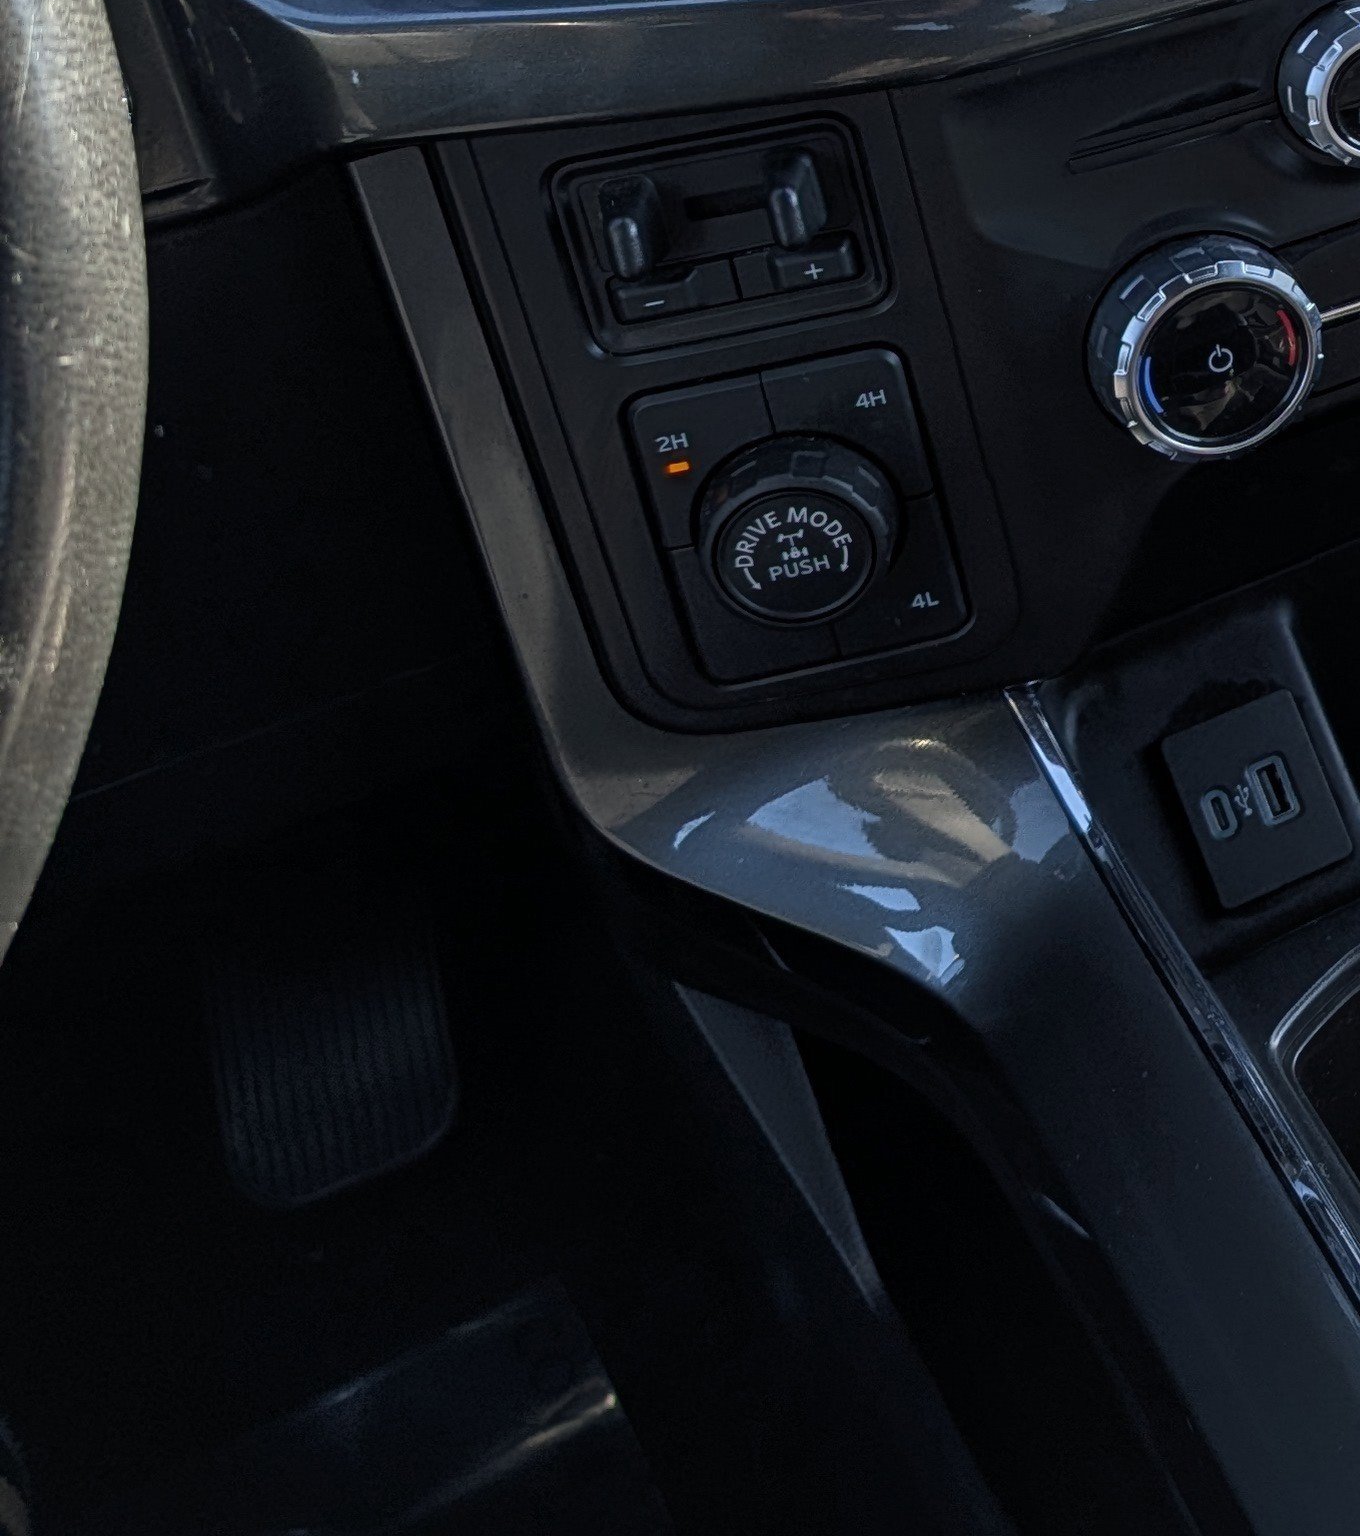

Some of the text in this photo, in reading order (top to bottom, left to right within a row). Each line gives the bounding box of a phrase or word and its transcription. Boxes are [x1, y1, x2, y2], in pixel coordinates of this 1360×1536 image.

[855, 388, 887, 410] 4H
[654, 431, 689, 452] 2H
[734, 506, 852, 569] DRIVE MODE
[767, 554, 831, 583] PUSH
[911, 591, 939, 610] 4L
